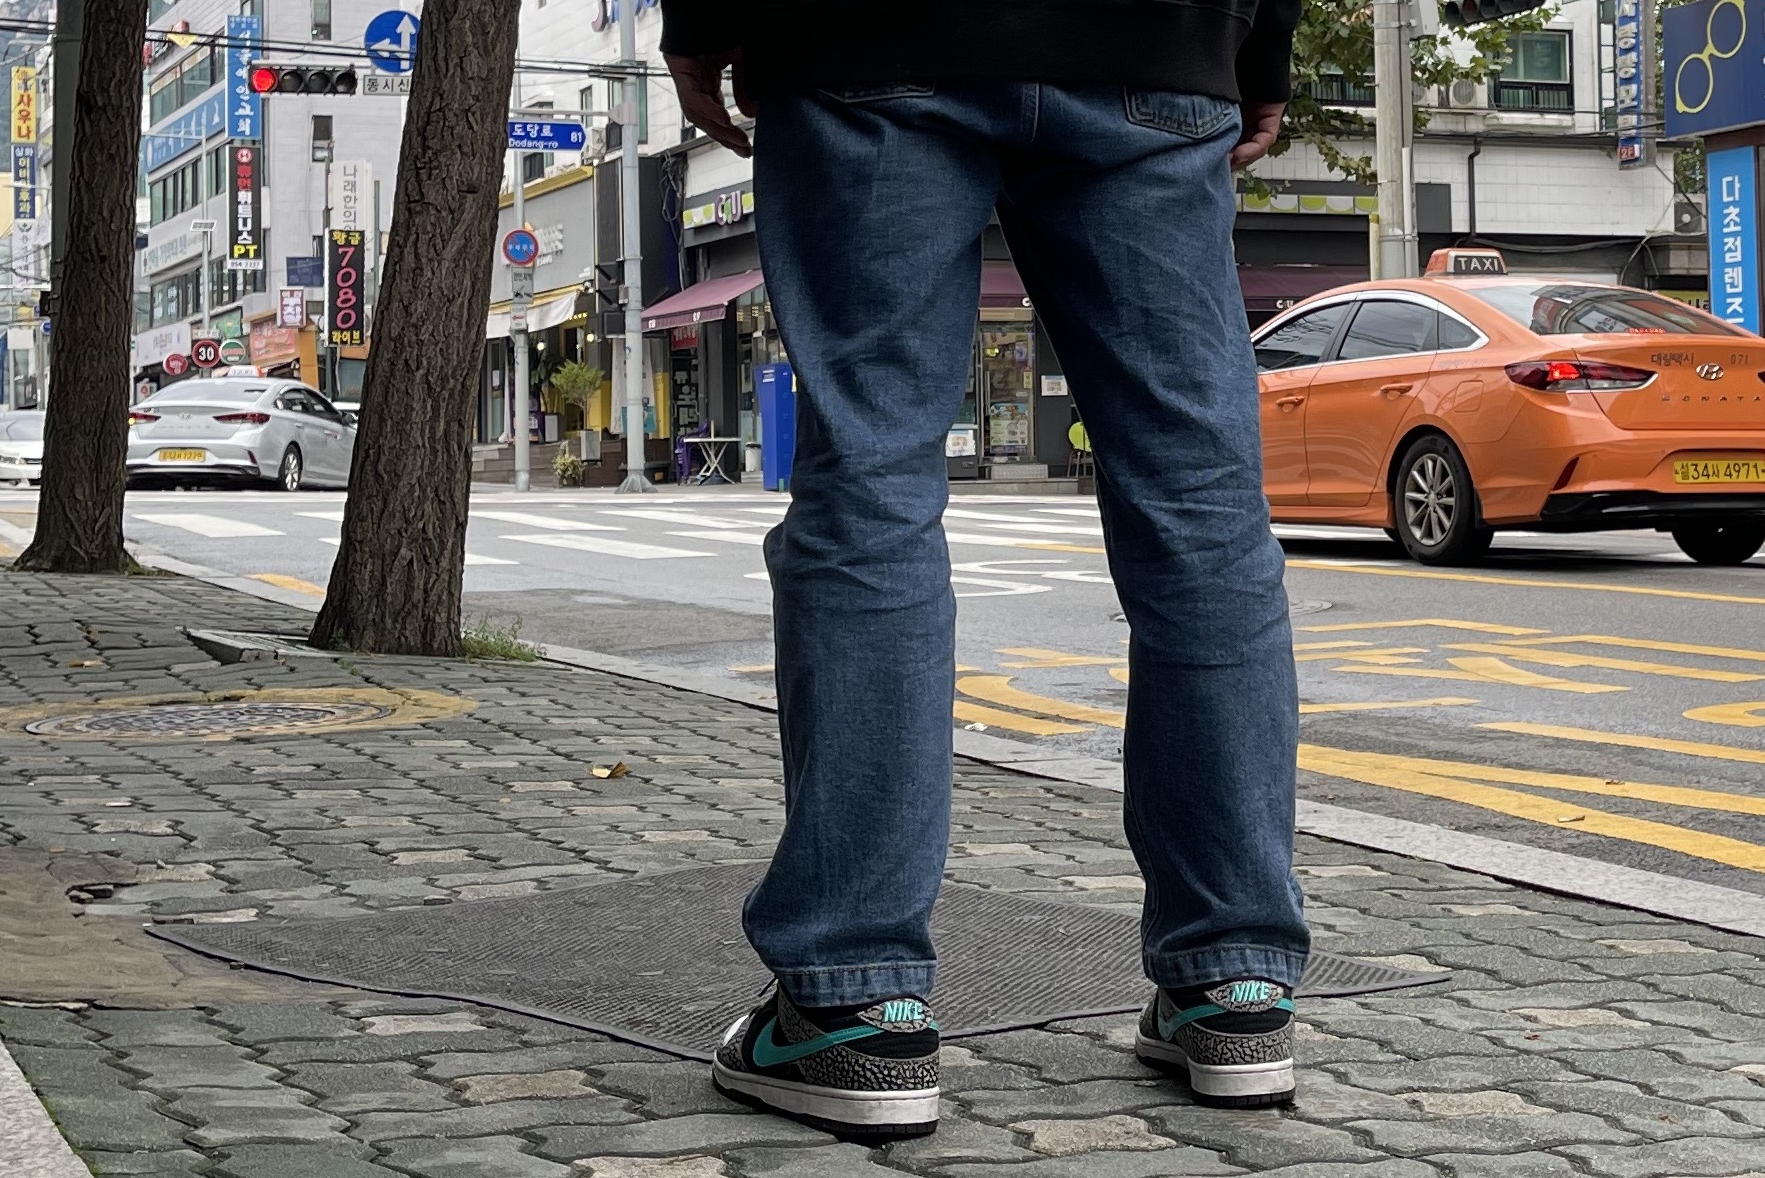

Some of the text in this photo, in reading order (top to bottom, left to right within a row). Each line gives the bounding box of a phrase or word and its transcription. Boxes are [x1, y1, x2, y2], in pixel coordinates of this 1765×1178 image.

[366, 78, 410, 93] 동시신
[17, 94, 32, 140] 사우나
[512, 124, 553, 138] 도당로
[570, 131, 583, 143] 81
[508, 138, 559, 150] Dodang-ro
[1620, 147, 1635, 160] 2F
[714, 190, 743, 226] CU
[332, 231, 361, 245] 황금
[233, 244, 258, 259] PT
[1721, 176, 1744, 324] 다초점렌즈
[1457, 256, 1500, 272] TAXI
[336, 247, 357, 329] 7080
[331, 330, 361, 344] 라이브
[198, 346, 215, 361] 30
[1230, 979, 1270, 1003] NIKE
[882, 999, 924, 1024] NIKE
